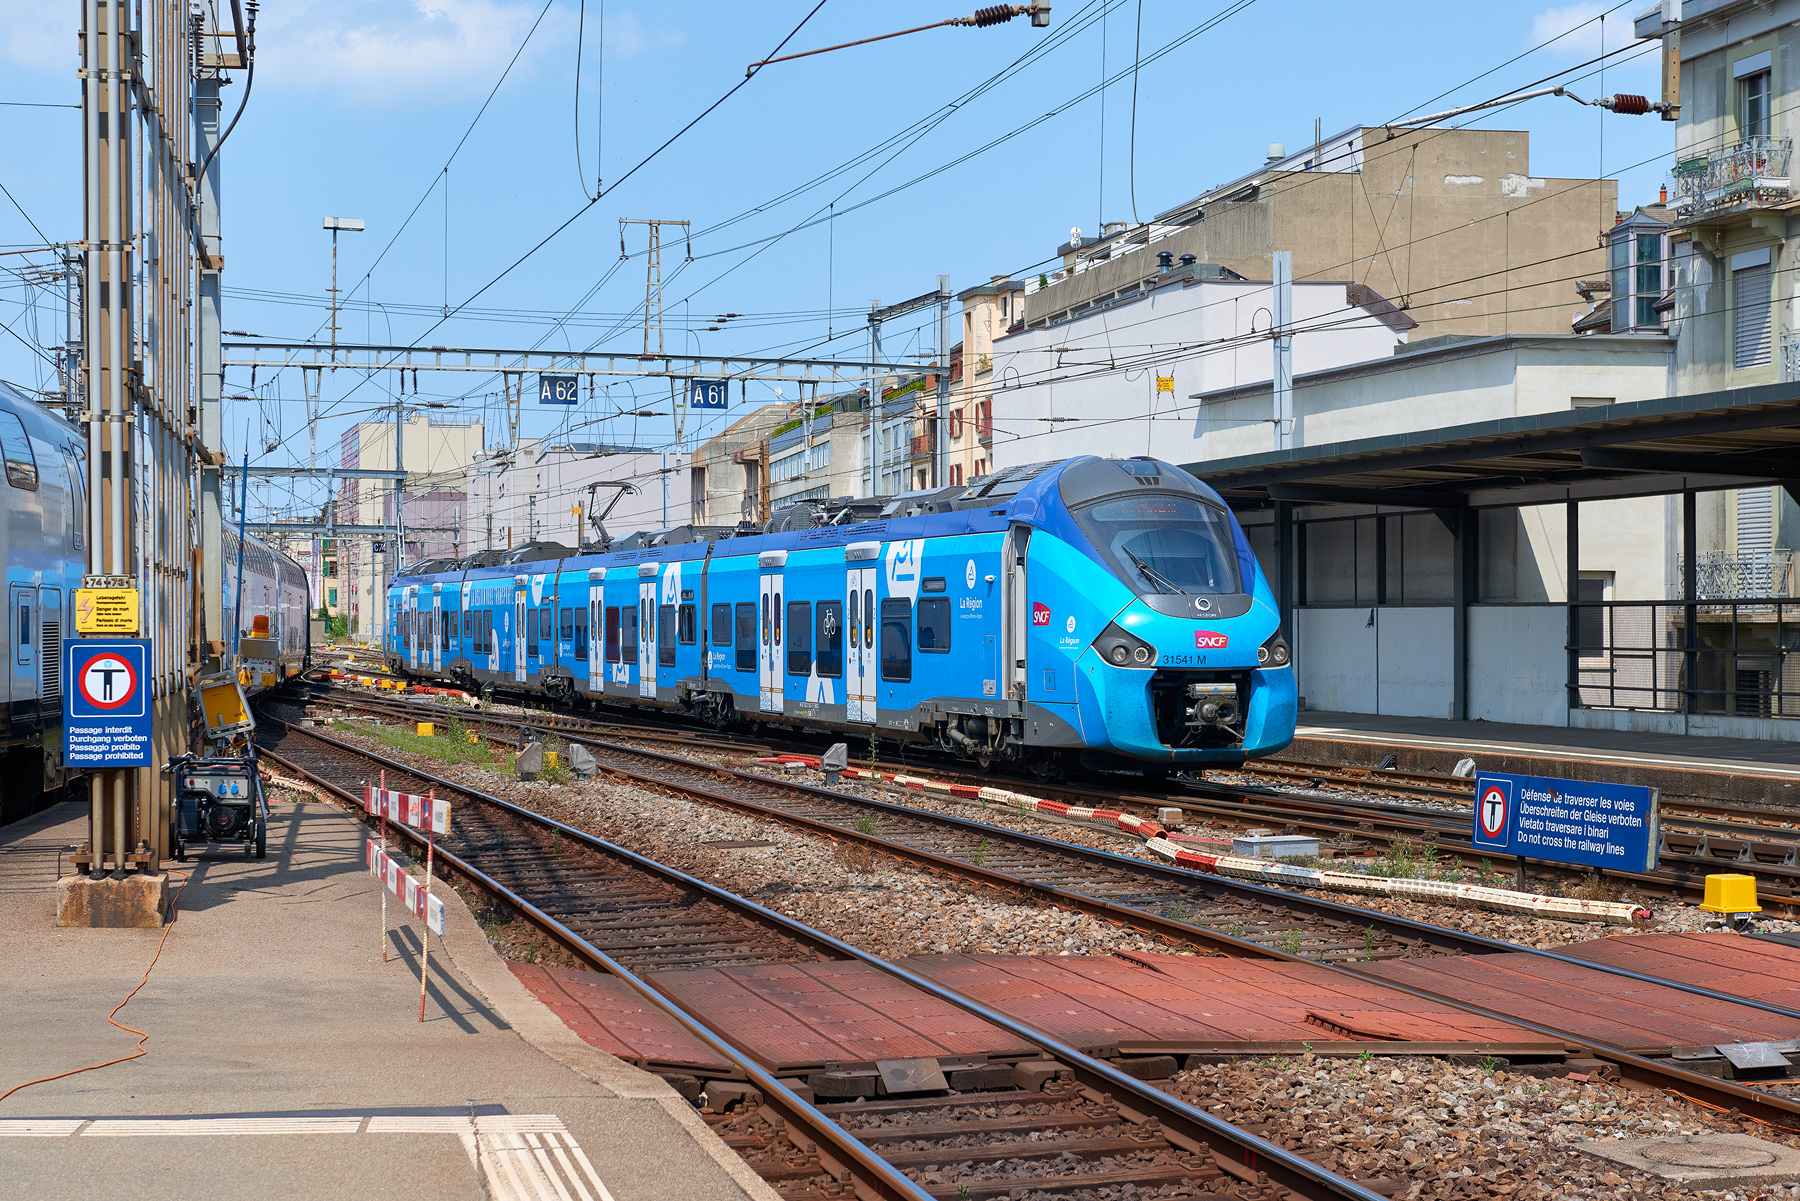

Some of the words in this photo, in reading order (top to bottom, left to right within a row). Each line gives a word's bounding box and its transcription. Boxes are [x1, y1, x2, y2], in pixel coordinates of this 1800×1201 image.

[541, 380, 551, 400] A
[556, 380, 577, 400] 62
[694, 385, 704, 404] A
[708, 385, 724, 405] 61
[90, 578, 102, 586] 74
[111, 578, 124, 586] 73
[960, 598, 966, 608] La
[966, 596, 982, 611] Région
[1034, 611, 1050, 623] SNCF
[1197, 637, 1226, 647] SNCF
[1163, 655, 1193, 664] 31541
[1197, 655, 1206, 664] M
[70, 726, 103, 735] Passage
[70, 744, 109, 752] Passaggio
[111, 744, 141, 752] proibito
[70, 752, 103, 761] Passage
[105, 752, 144, 760] prohibited
[1521, 788, 1551, 802] Défense
[1564, 793, 1598, 807] traverser
[1600, 796, 1612, 810] les
[1614, 799, 1635, 811] voies
[1520, 801, 1569, 819] Überschreiten
[1570, 809, 1582, 820] der
[1584, 810, 1607, 823] Gleise
[1608, 814, 1642, 827] verboten
[1519, 817, 1544, 831] Vietato
[1545, 820, 1583, 835] traversare
[1584, 825, 1587, 836] i
[1587, 825, 1609, 839] binari
[1518, 830, 1528, 842] Do
[1529, 833, 1541, 844] not
[1542, 835, 1563, 847] cross
[1564, 837, 1576, 849] the
[1578, 840, 1605, 855] railway
[1606, 842, 1625, 856] lines
